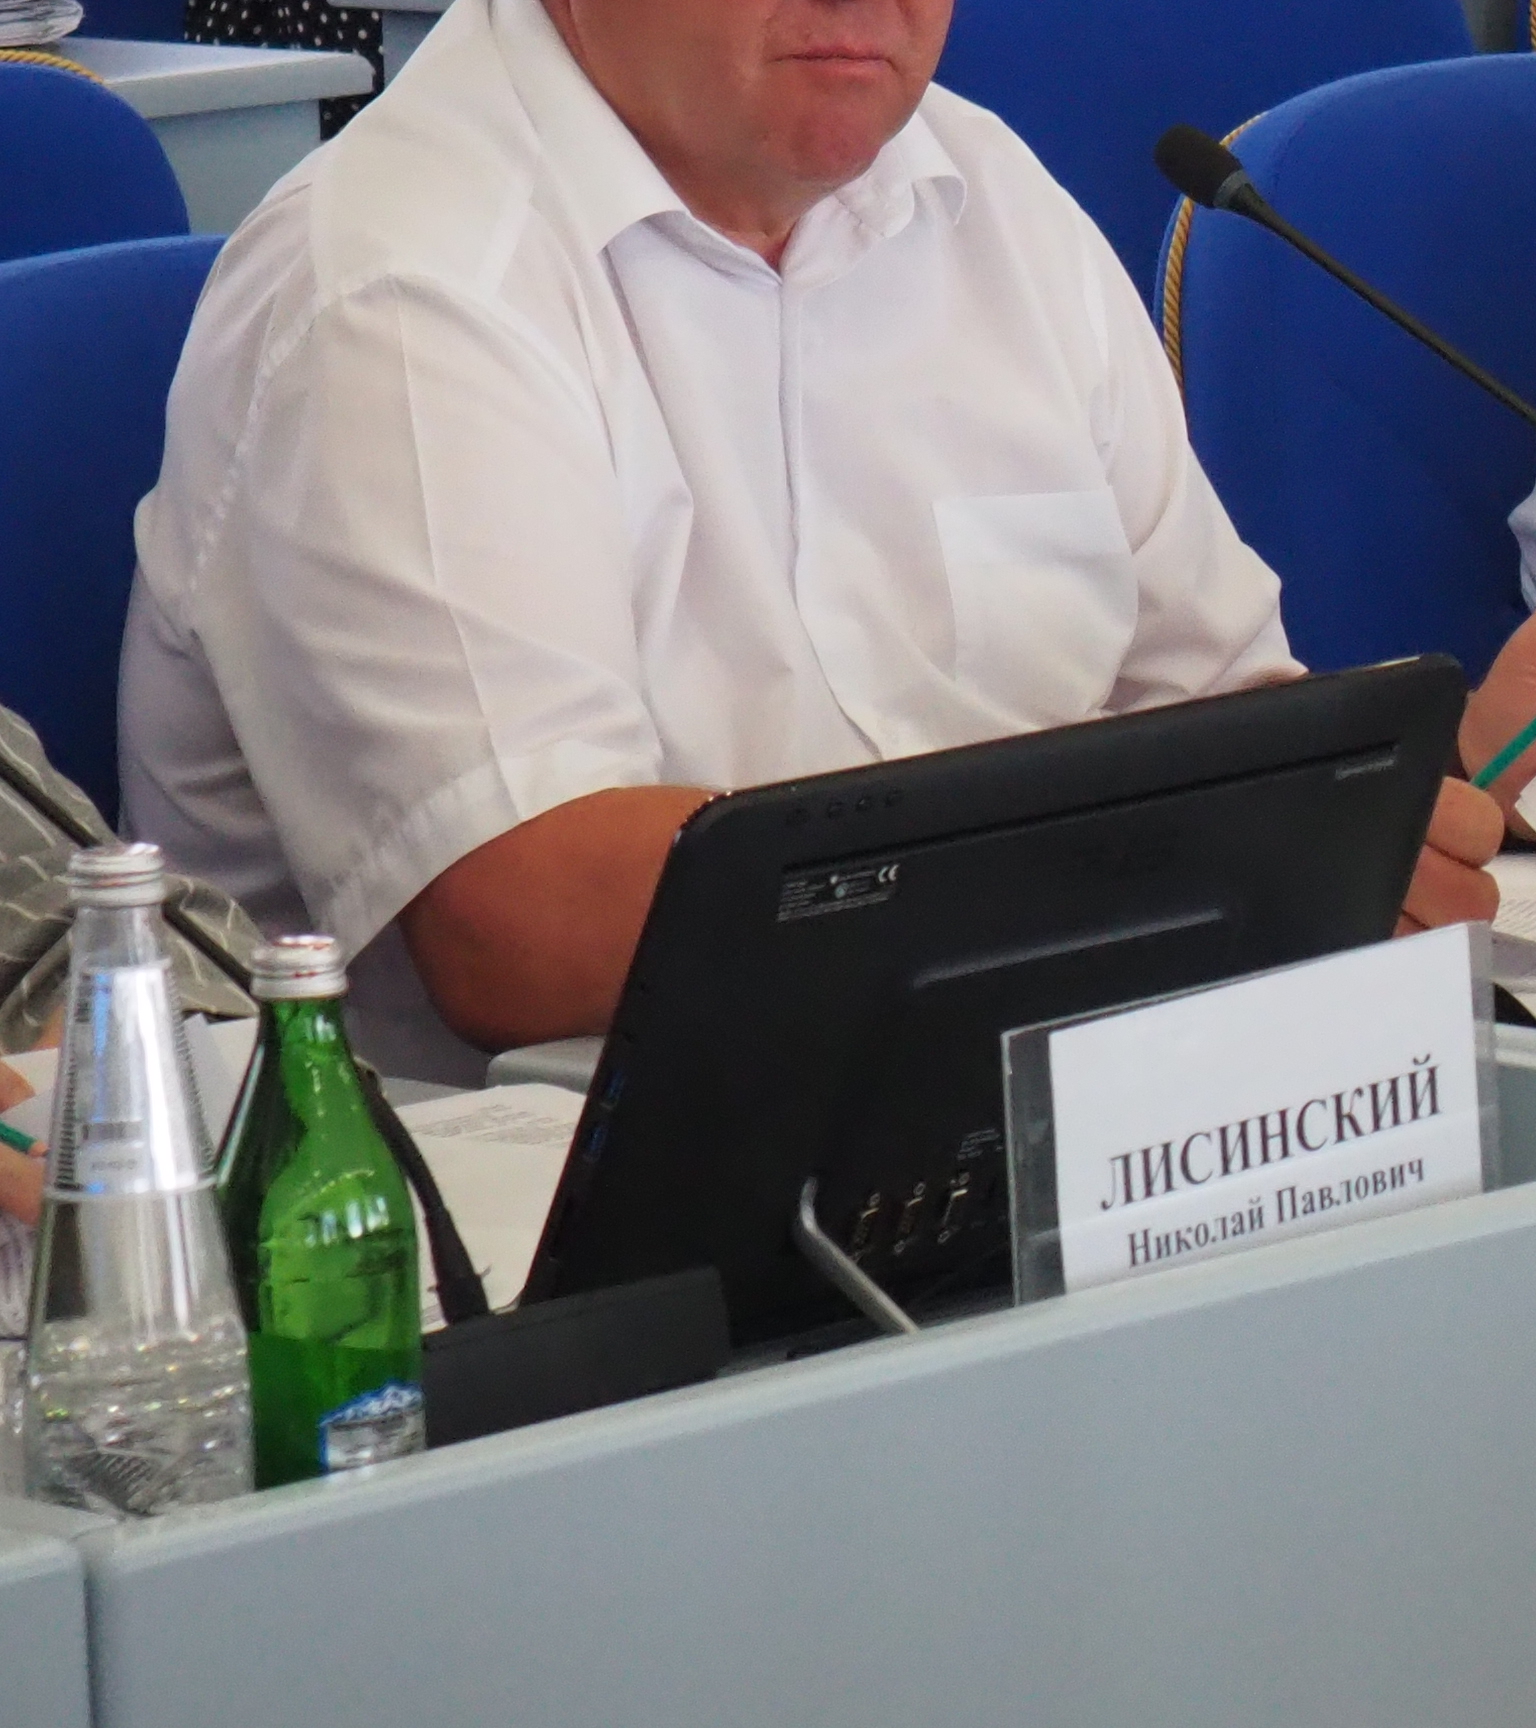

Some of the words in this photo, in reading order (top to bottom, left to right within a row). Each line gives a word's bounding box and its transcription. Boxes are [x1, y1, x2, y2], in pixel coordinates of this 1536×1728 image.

[1101, 1054, 1440, 1211] ЛИСИНСКИЙ
[1128, 1197, 1264, 1269] Николай
[1276, 1158, 1424, 1224] Павлович
